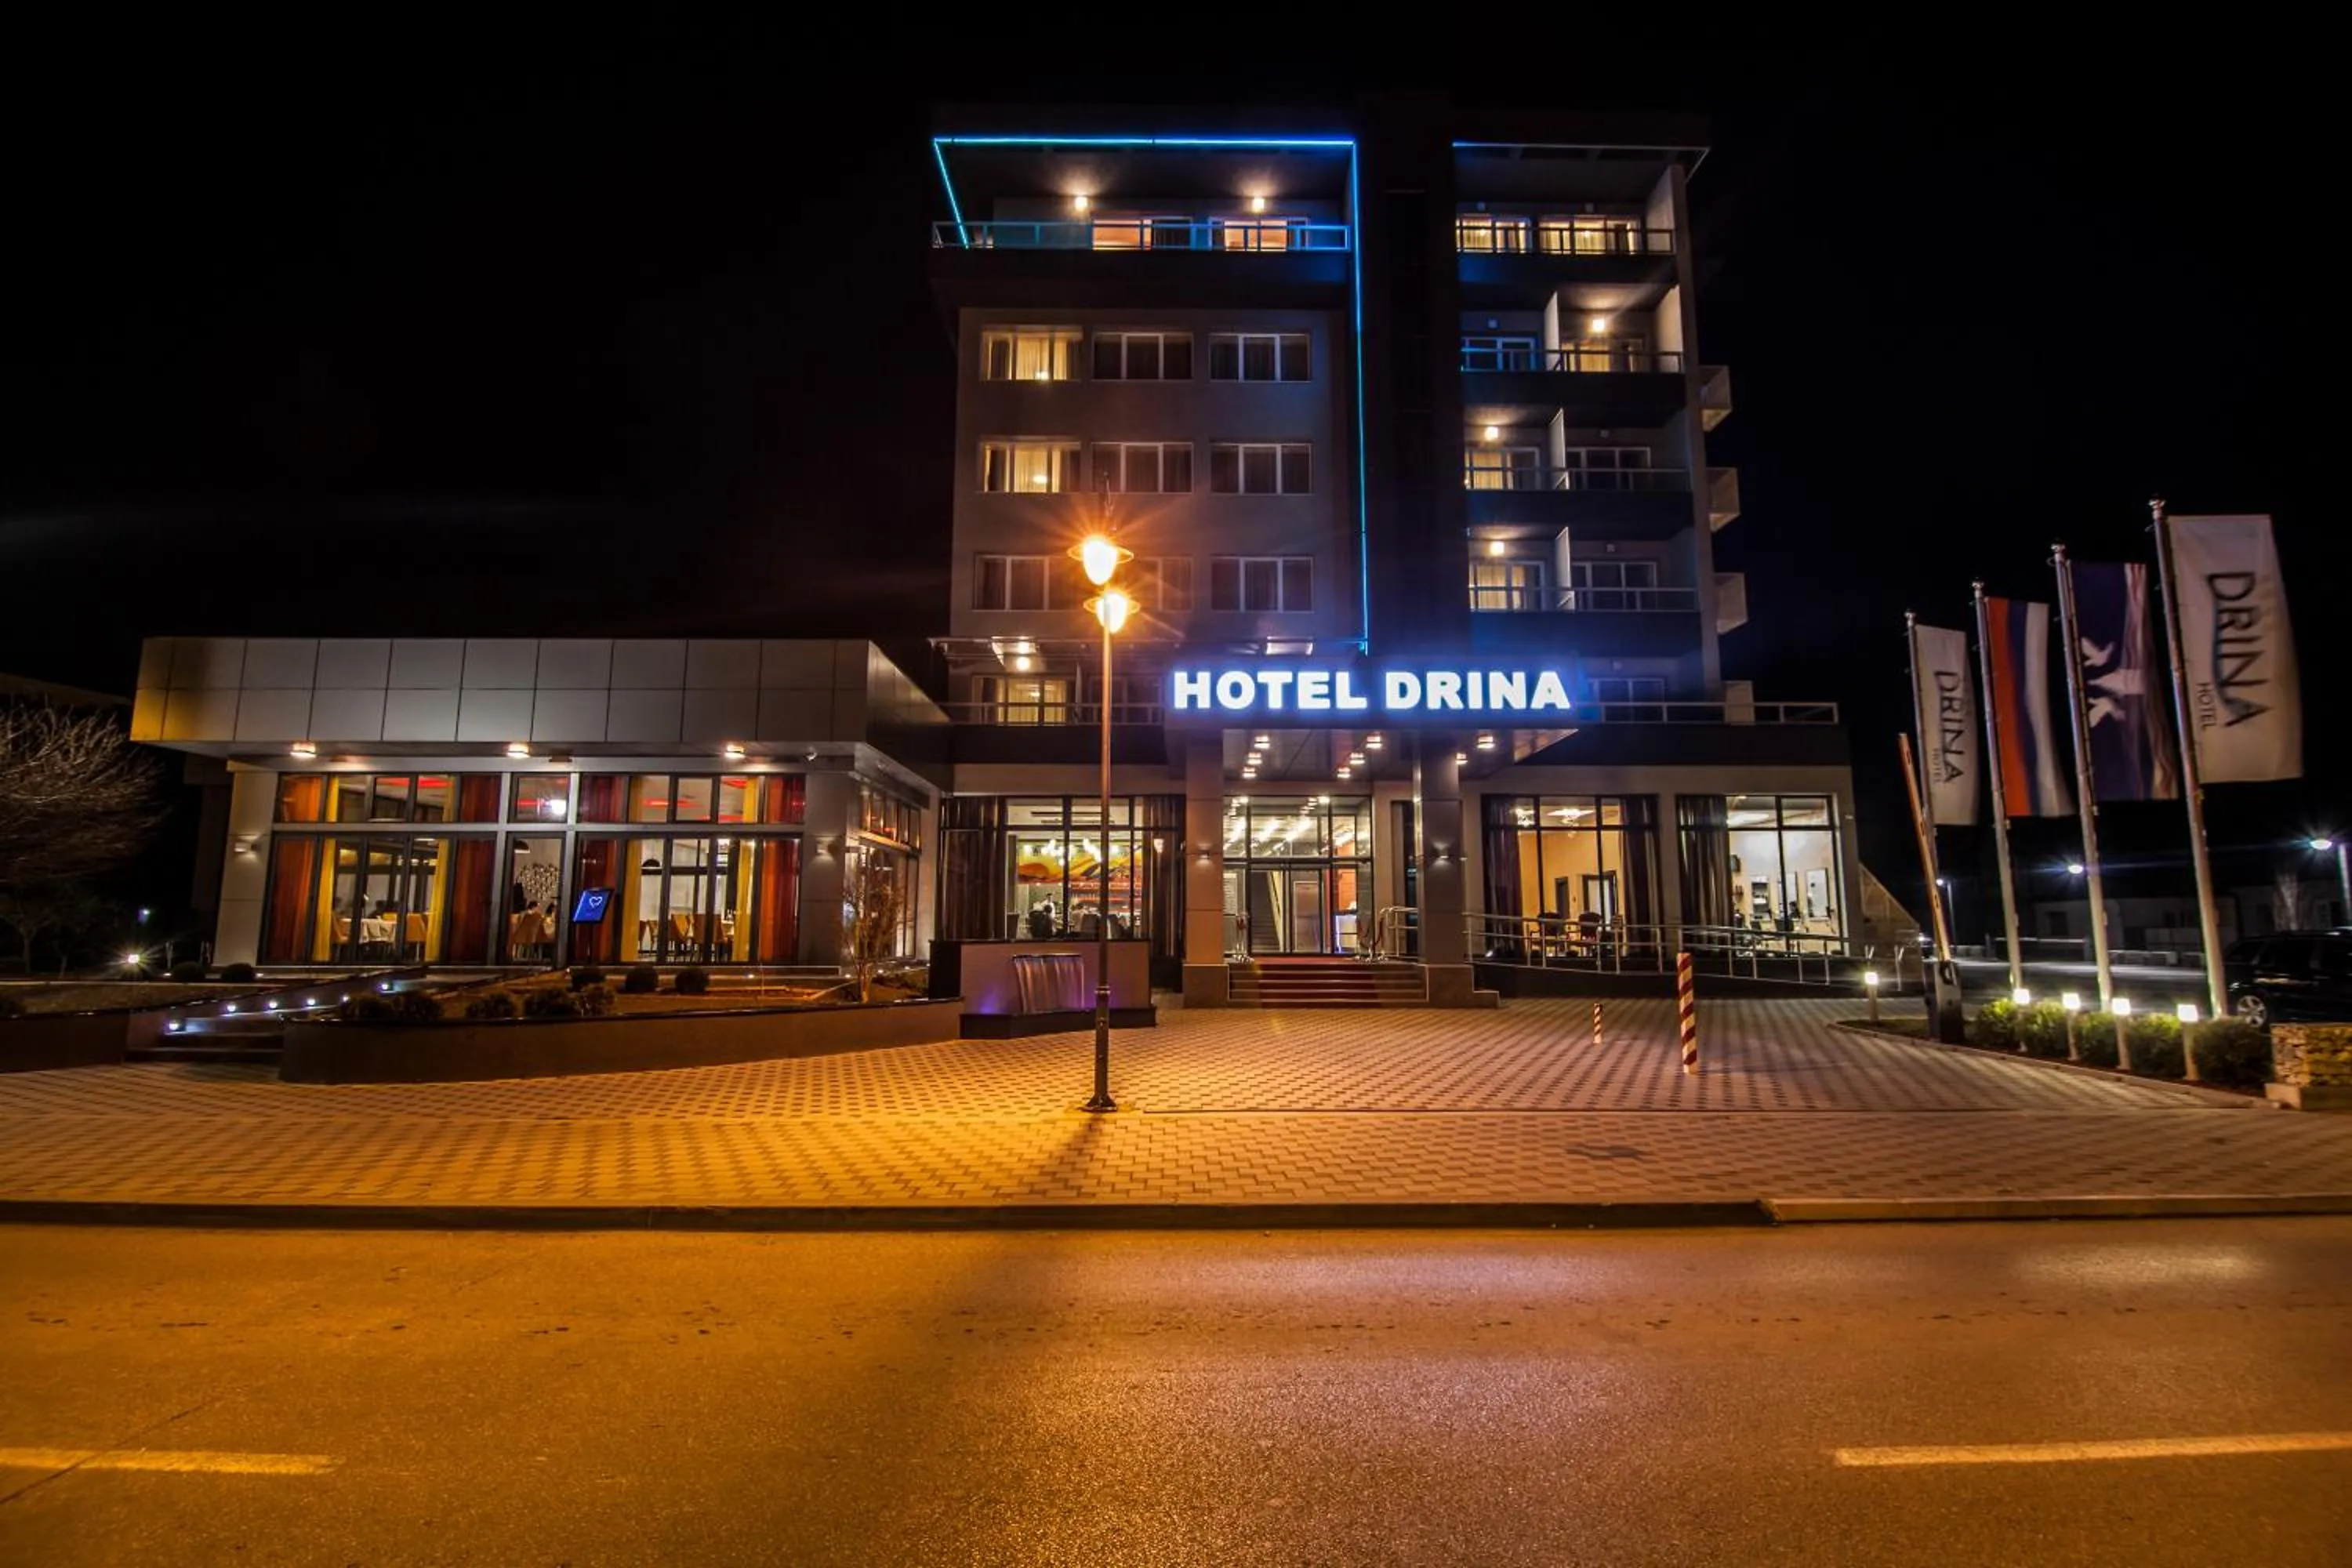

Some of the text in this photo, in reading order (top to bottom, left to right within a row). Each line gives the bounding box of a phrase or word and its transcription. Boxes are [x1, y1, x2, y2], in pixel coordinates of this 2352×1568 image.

[1175, 671, 1571, 709] HOTEL DRINA
[2206, 571, 2272, 728] DRINA
[1933, 670, 1965, 783] DRINA
[2196, 681, 2216, 731] HOTEL
